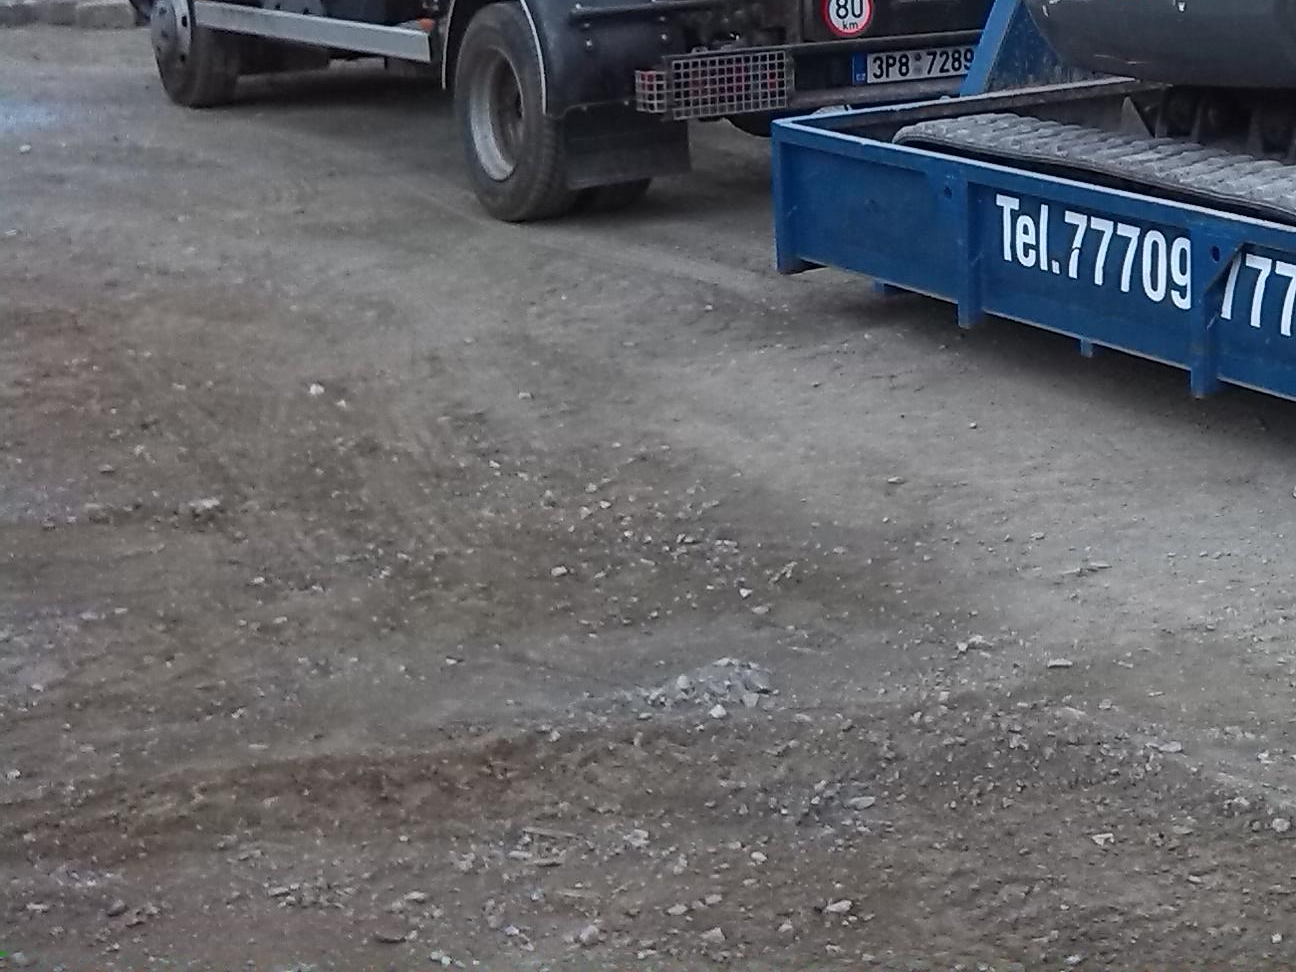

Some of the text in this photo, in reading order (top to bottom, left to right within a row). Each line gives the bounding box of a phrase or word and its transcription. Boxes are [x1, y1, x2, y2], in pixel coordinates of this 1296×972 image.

[842, 18, 859, 30] km
[872, 54, 910, 79] 3P8
[926, 48, 975, 75] 7289
